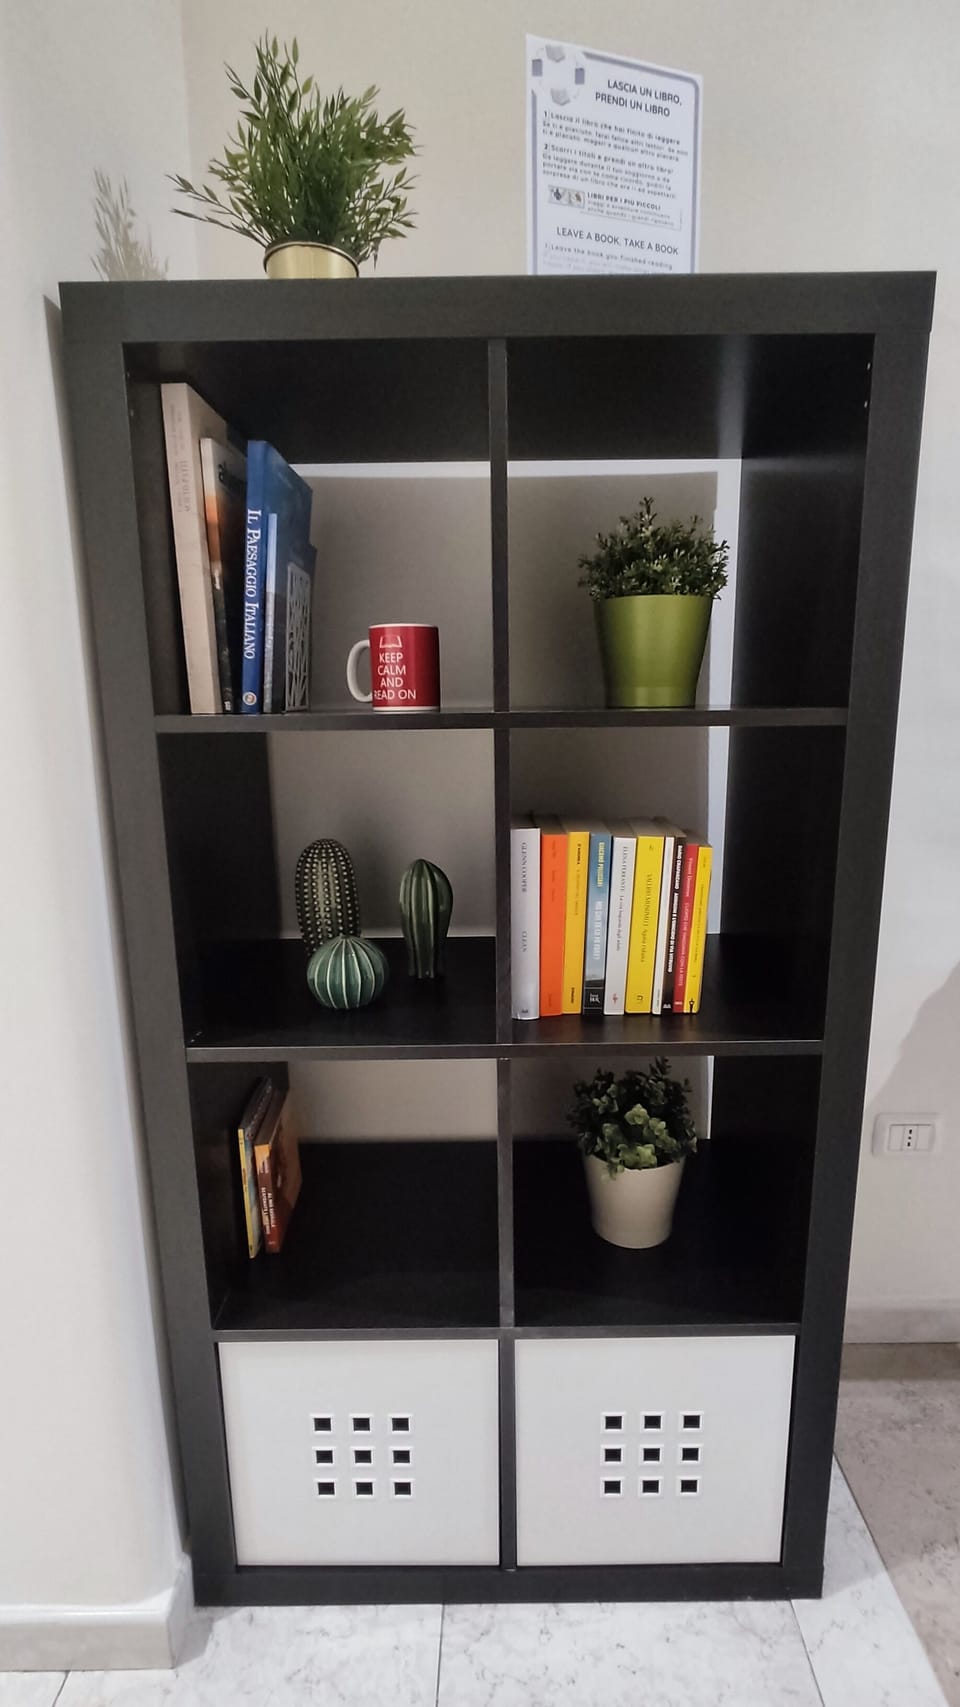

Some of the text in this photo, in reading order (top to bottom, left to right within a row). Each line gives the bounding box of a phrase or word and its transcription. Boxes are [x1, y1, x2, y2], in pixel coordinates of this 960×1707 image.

[595, 91, 670, 117] PRENDI UN LIBRO
[607, 79, 681, 106] LASCIA UN LIBRO,
[550, 112, 573, 123] Lascia
[582, 118, 597, 128] libro
[600, 122, 611, 131] che
[614, 125, 624, 133] hai
[627, 127, 644, 137] finito
[647, 131, 652, 139] di
[655, 134, 679, 146] leggere
[542, 161, 566, 172] portare
[551, 144, 571, 155] Scorri
[578, 150, 595, 159] titoli
[603, 155, 625, 166] prendi
[628, 159, 635, 167] un
[638, 161, 654, 170] altro
[553, 155, 577, 166] leggere
[579, 160, 604, 170] durante
[587, 191, 603, 201] LIBRI
[605, 194, 617, 203] PER
[556, 226, 678, 254] LEAVE A BOOK, TAKE A BOOK
[551, 244, 571, 252] Leave
[587, 249, 602, 257] book
[605, 253, 617, 261] you
[620, 254, 645, 263] finished
[647, 260, 672, 270] reading
[245, 529, 261, 598] PAESAGGIO
[243, 601, 259, 659] ITALIANO
[377, 664, 407, 676] CALM
[379, 652, 403, 663] KEEP
[374, 689, 417, 700] READ ON
[380, 677, 404, 688] AND
